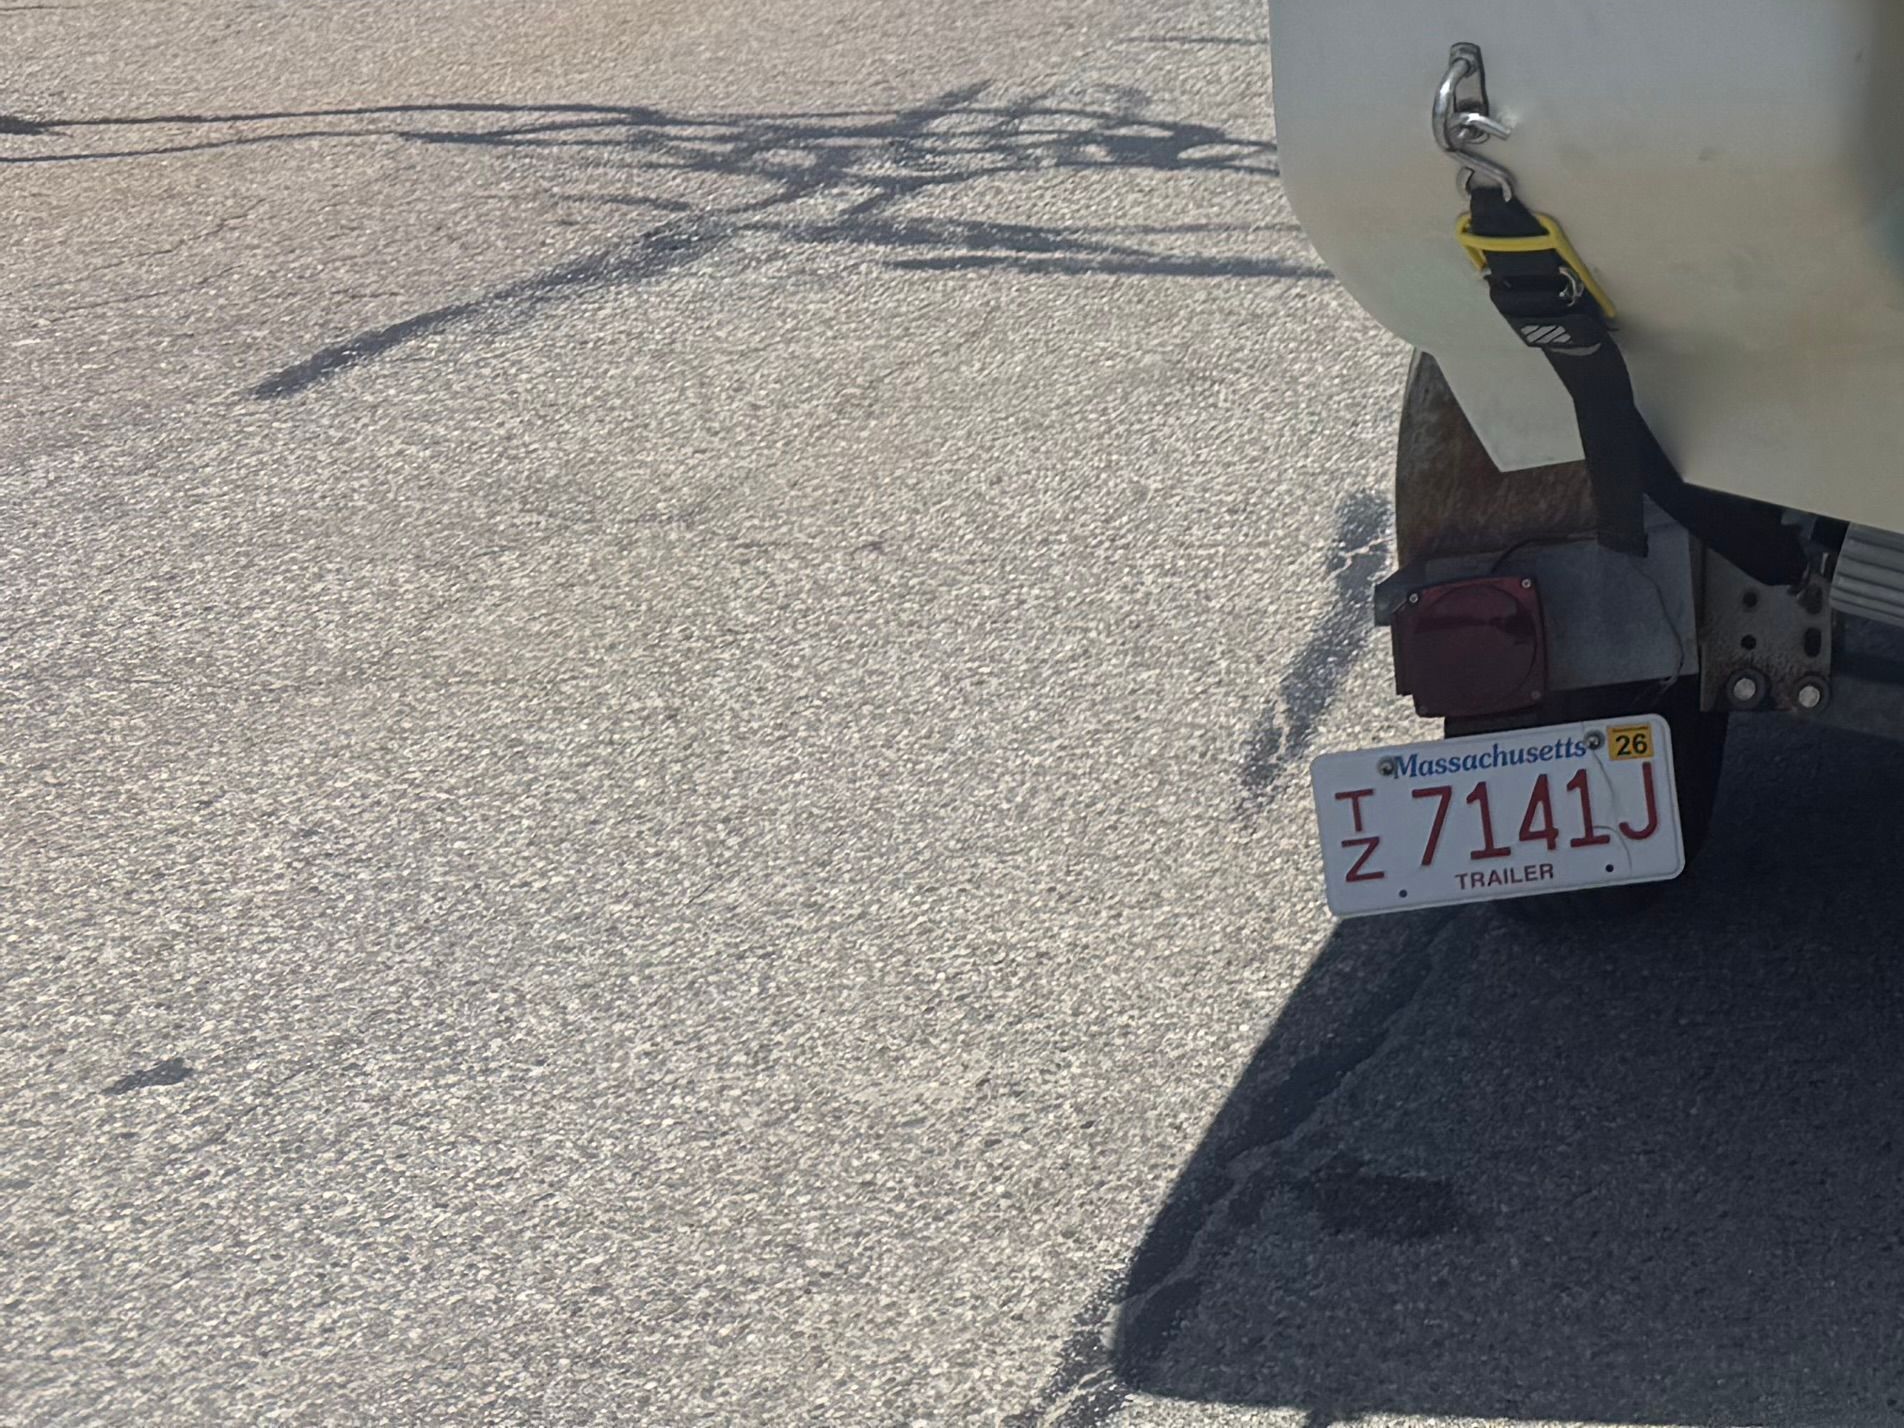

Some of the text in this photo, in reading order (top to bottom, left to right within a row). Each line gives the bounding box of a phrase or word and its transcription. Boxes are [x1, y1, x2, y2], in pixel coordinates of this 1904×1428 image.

[1394, 737, 1588, 780] Massachusetts
[1616, 733, 1648, 757] 26
[1411, 761, 1659, 867] 7141J
[1455, 863, 1555, 891] TRAILER
